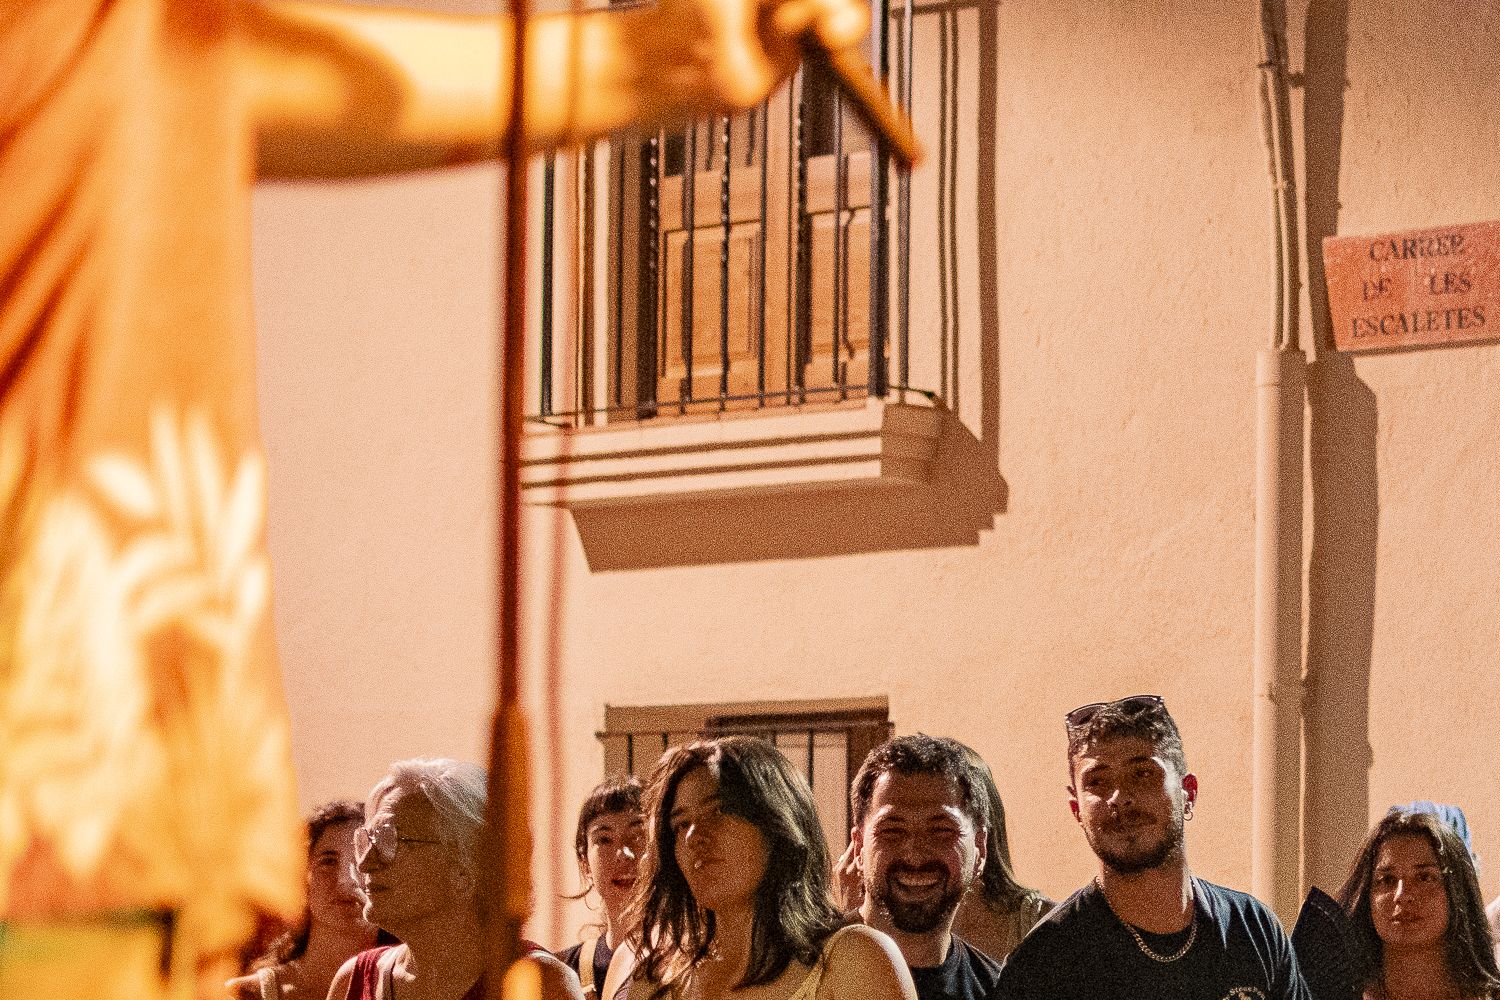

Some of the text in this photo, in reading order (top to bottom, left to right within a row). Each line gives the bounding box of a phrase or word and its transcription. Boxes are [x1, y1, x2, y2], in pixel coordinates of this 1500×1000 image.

[1362, 271, 1472, 301] DE LES
[1351, 305, 1486, 339] ESCALETES
